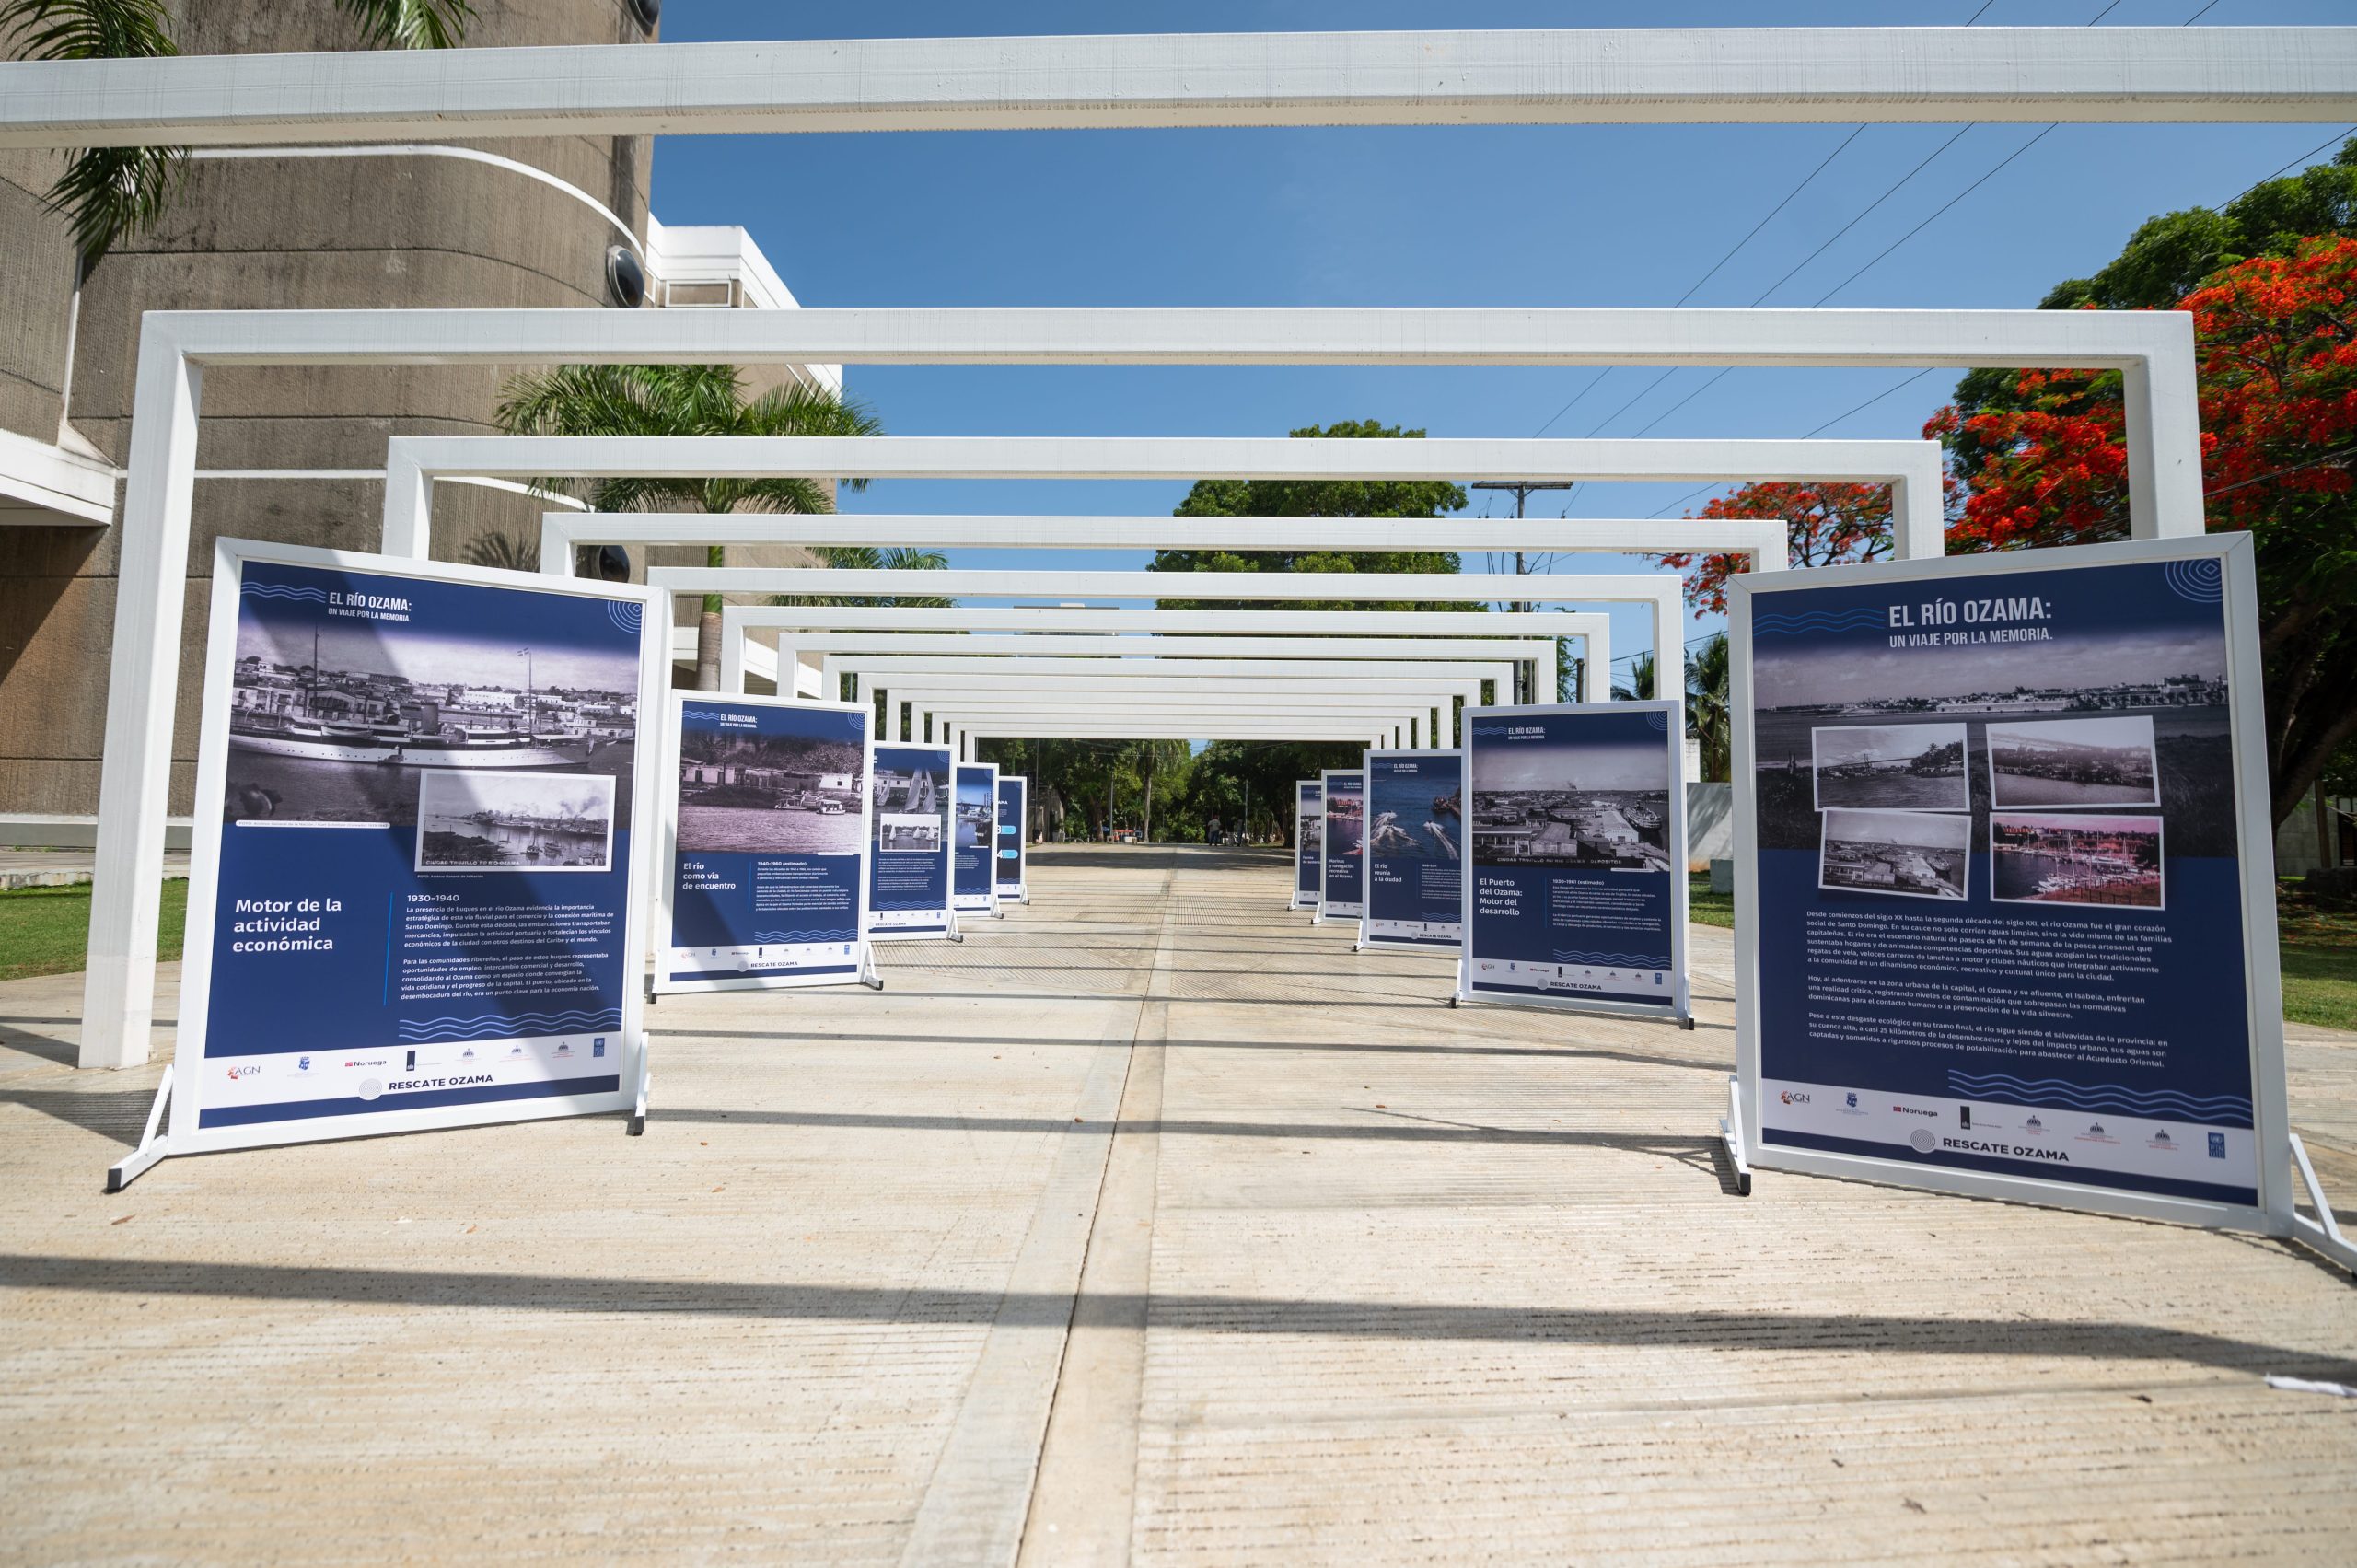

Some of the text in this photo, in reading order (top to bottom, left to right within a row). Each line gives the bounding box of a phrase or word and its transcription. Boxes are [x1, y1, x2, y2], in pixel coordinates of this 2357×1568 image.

[330, 592, 412, 611] EL RÍO OZAMA:
[339, 609, 355, 617] VIAJE
[380, 612, 411, 622] MEMORIA.
[1889, 597, 2052, 627] EL RÍO OZAMA:
[1890, 627, 2053, 648] UN VIAJE POR LA MEMORIA.
[727, 713, 737, 722] RÍO
[737, 715, 758, 724] OZAMA:
[1515, 726, 1525, 735] RÍO
[693, 862, 704, 870] río
[1489, 878, 1515, 887] Puerto
[1493, 889, 1523, 897] Ozama:
[236, 897, 342, 913] Motor de la
[1504, 898, 1517, 906] del
[1480, 907, 1520, 916] desarrollo
[234, 917, 320, 933] actividad
[1876, 912, 1892, 922] siglo
[1933, 915, 1963, 924] segunda
[2005, 918, 2024, 927] siglo
[2026, 919, 2039, 928] XXI,
[2133, 923, 2165, 932] corazón
[233, 936, 333, 953] económica
[1807, 974, 1822, 983] Hoy,
[1831, 975, 1867, 984] adentrarse
[1950, 983, 1977, 993] capital,
[2030, 989, 2063, 999] afluente,
[2074, 992, 2105, 1002] Isabela,
[2106, 993, 2145, 1003] enfrentan
[234, 1066, 261, 1075] AGN
[389, 1074, 493, 1090] RESCATE OZAMA
[1787, 1092, 1810, 1103] AGN
[1902, 1107, 1938, 1117] Noruega
[1943, 1137, 2069, 1162] RESCATE OZAMA
